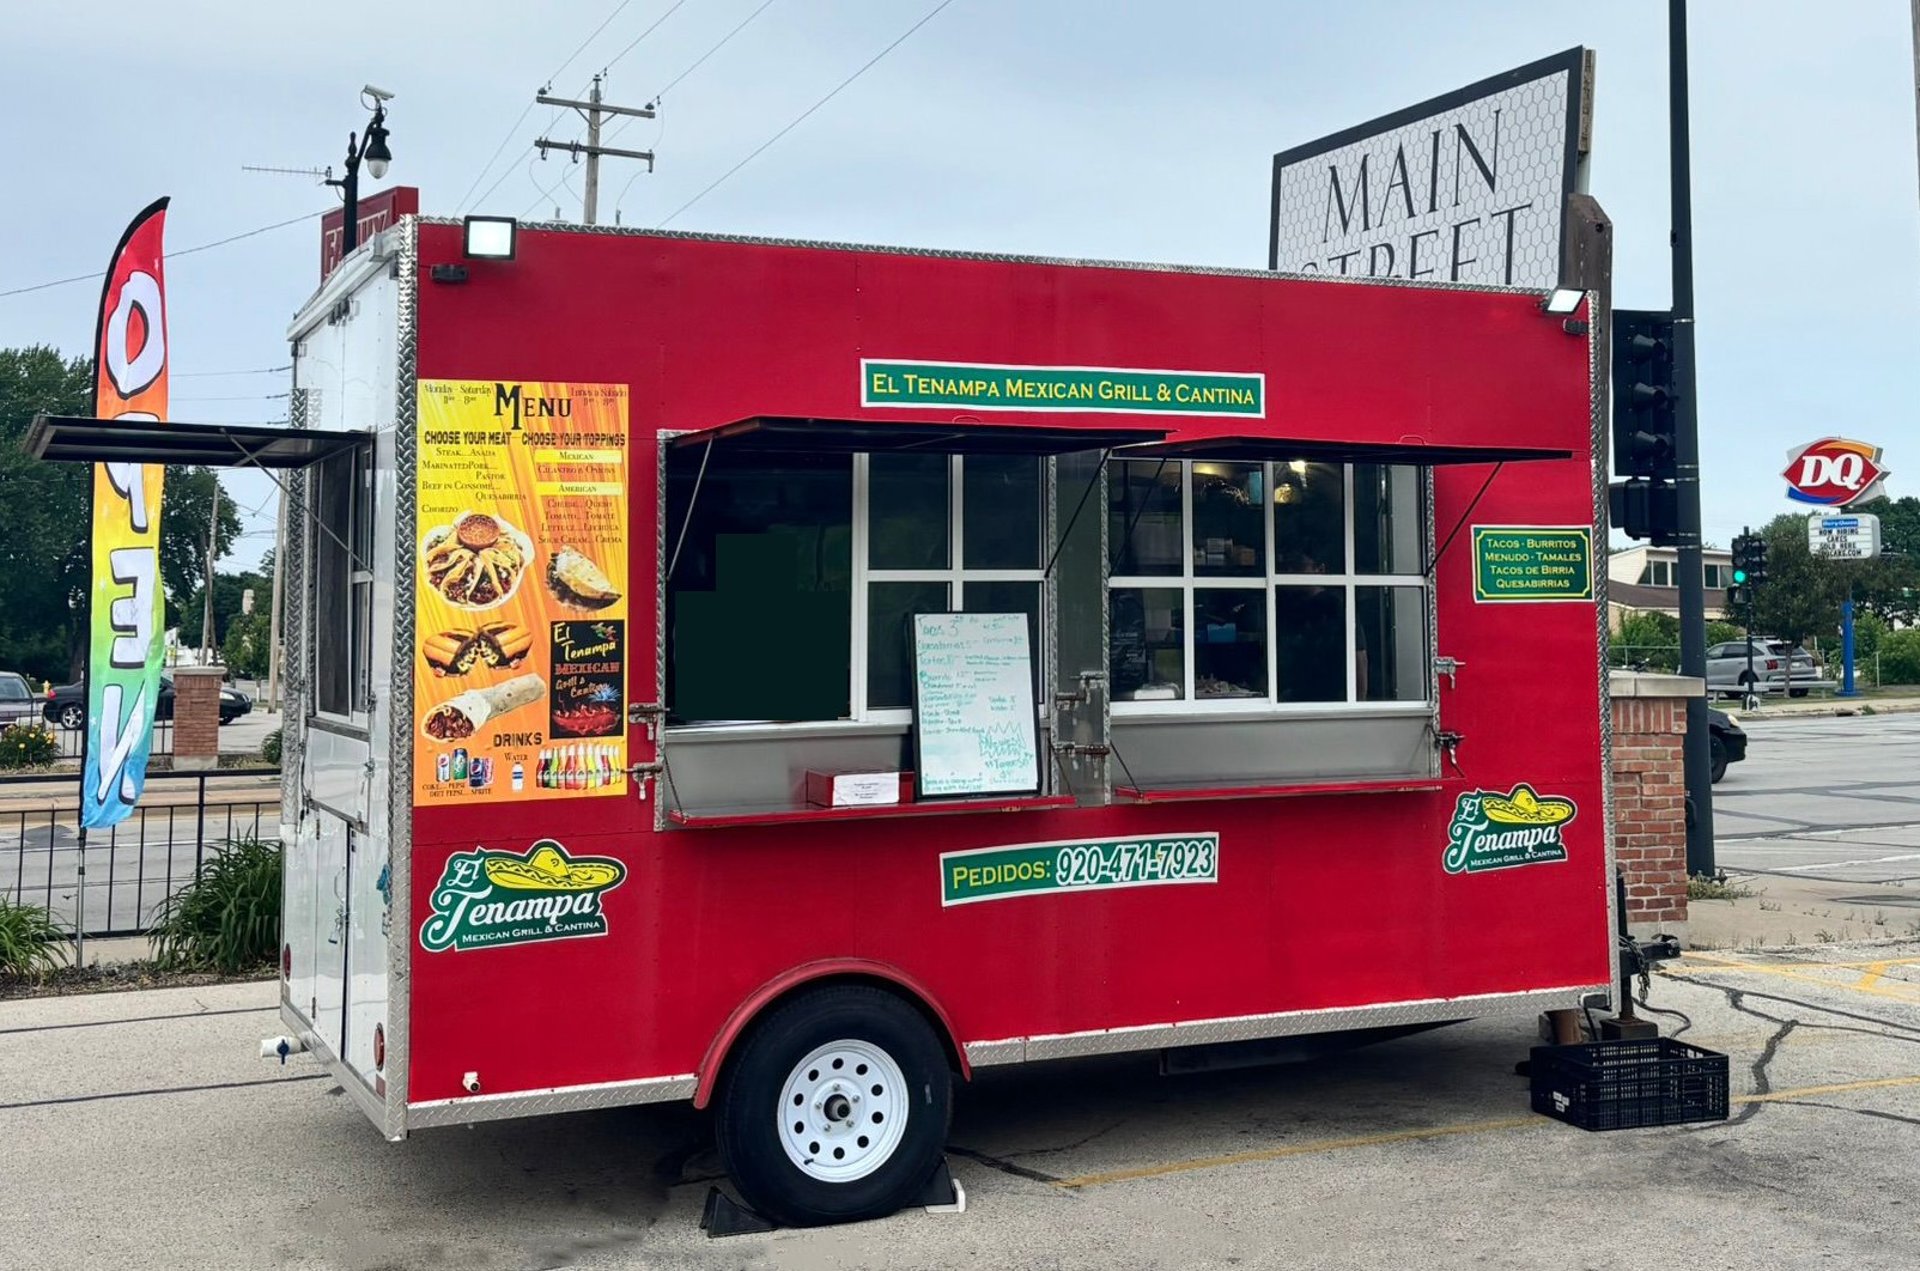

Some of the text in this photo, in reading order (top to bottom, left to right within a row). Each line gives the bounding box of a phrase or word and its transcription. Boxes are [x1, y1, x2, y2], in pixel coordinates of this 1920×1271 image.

[1322, 108, 1502, 243] MAIN
[872, 373, 1255, 404] EL TENAMPA MEXICAN GRILL & CANTINA
[493, 382, 572, 430] MENU
[424, 431, 512, 445] CHOOSE YOUR MEAT
[521, 432, 625, 446] CHOOSE YOUR TOPPINGS
[559, 451, 594, 460] MEXICAN
[475, 470, 506, 480] PASTOR
[1798, 453, 1864, 490] DQ
[422, 481, 443, 490] BEEF
[559, 484, 597, 493] AMERICAN
[421, 504, 459, 513] CHORIZO
[1486, 538, 1577, 549] TACOS BURRITOS
[1485, 552, 1582, 562] MENUDO TAMALES
[1490, 565, 1575, 575] TACOS DE BIRRIA
[1495, 578, 1570, 589] QUESABIRRIAS
[553, 621, 570, 643] El
[561, 639, 616, 661] Tenampa
[555, 662, 620, 675] MEXICAN
[493, 732, 543, 747] DRINKS
[504, 752, 528, 761] WATER
[1457, 796, 1482, 821] El
[1447, 819, 1557, 868] Tenampa
[1056, 840, 1215, 887] 920-471-7923
[1470, 857, 1503, 867] MEXICAN
[1503, 855, 1524, 863] GRILL
[1532, 849, 1562, 859] CANTINA
[446, 856, 485, 888] El
[952, 861, 1051, 889] PEDIDOS:
[427, 884, 595, 944] Tenampa
[462, 920, 601, 944] MEXICAN GRILL & CANTINA
